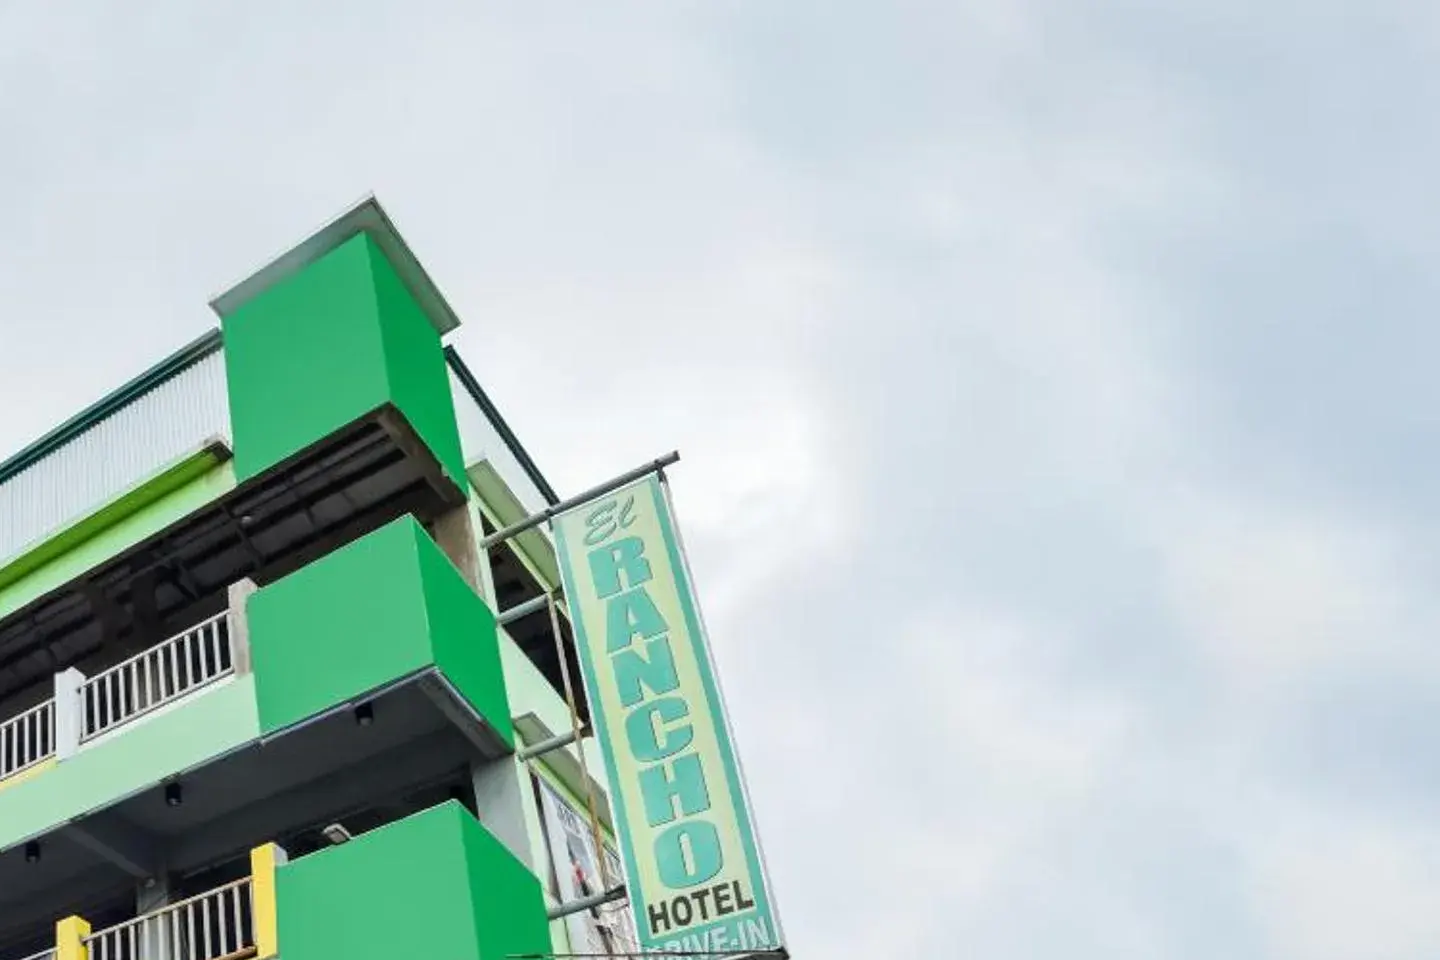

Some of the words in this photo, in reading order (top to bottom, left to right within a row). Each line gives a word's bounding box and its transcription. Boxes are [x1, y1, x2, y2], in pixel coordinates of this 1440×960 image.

[583, 495, 638, 546] El
[587, 536, 724, 890] RANCHO
[647, 880, 755, 935] HOTEL
